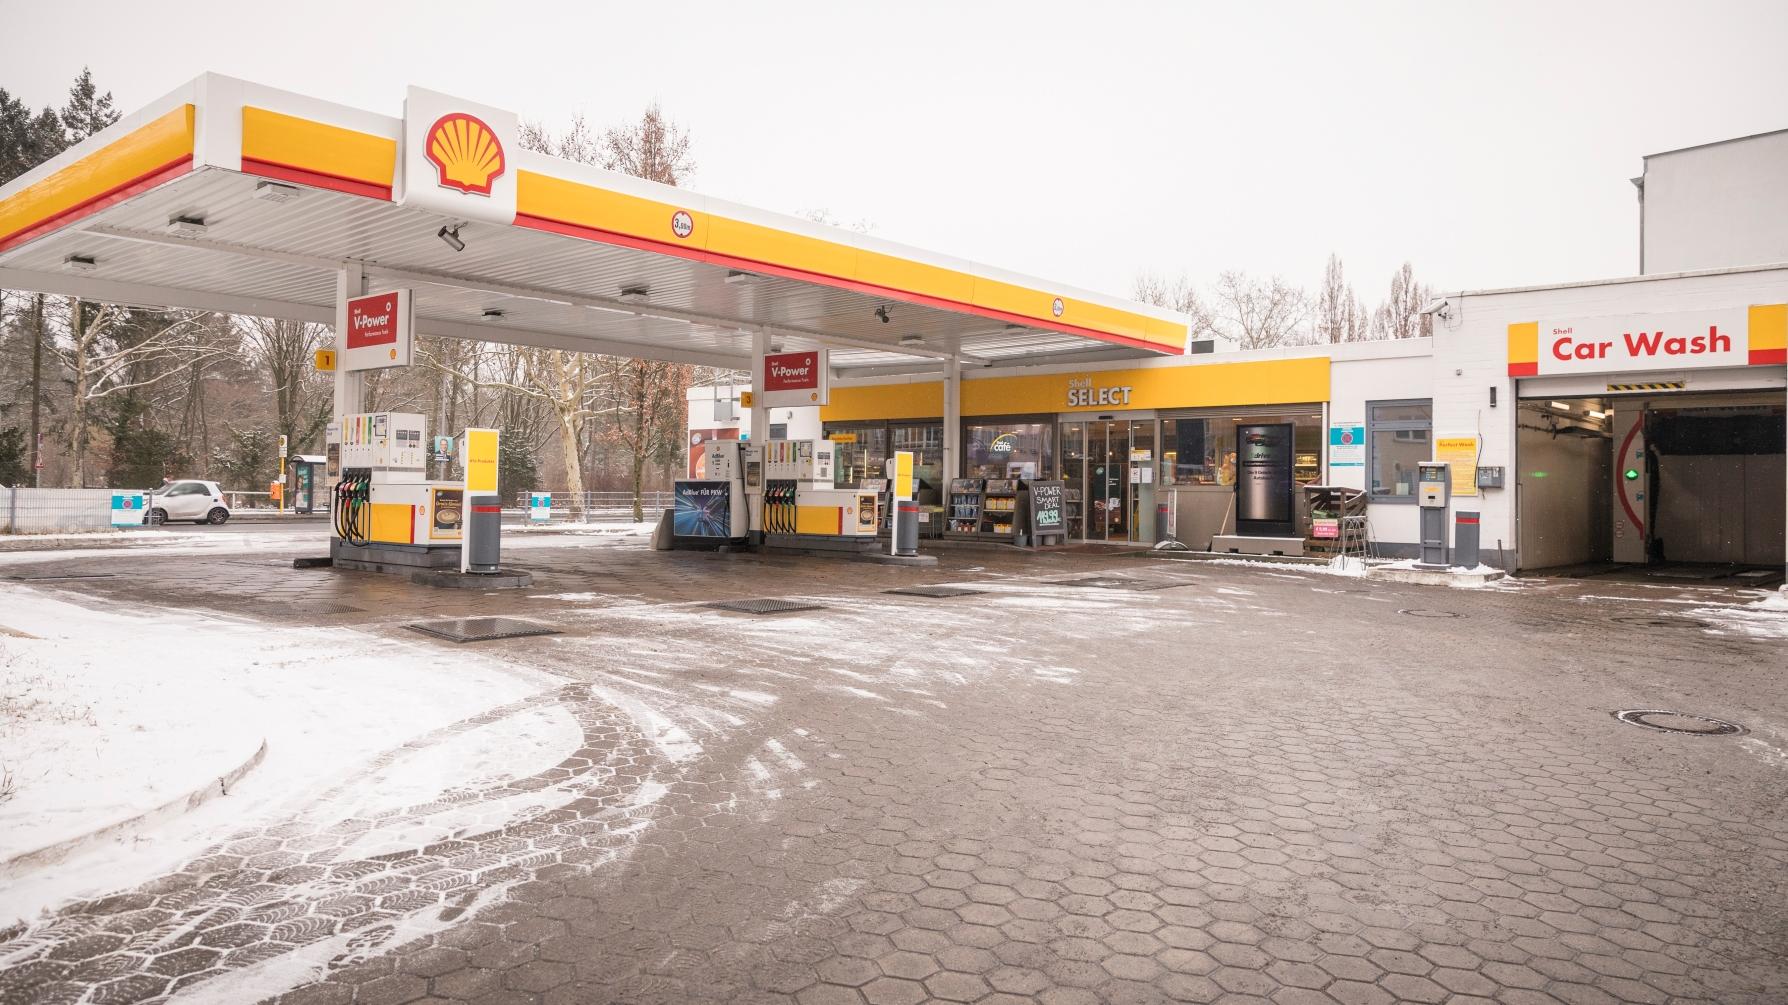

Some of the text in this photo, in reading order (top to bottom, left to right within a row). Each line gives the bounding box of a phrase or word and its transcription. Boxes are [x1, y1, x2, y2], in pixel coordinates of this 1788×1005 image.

[354, 314, 389, 330] V-Power
[1552, 326, 1730, 360] Car Wash
[325, 355, 330, 366] 1
[772, 366, 809, 378] V-Power
[1069, 378, 1092, 388] Shell
[1068, 386, 1132, 406] SELECT
[994, 442, 1011, 452] café
[1033, 486, 1062, 496] V-POWER
